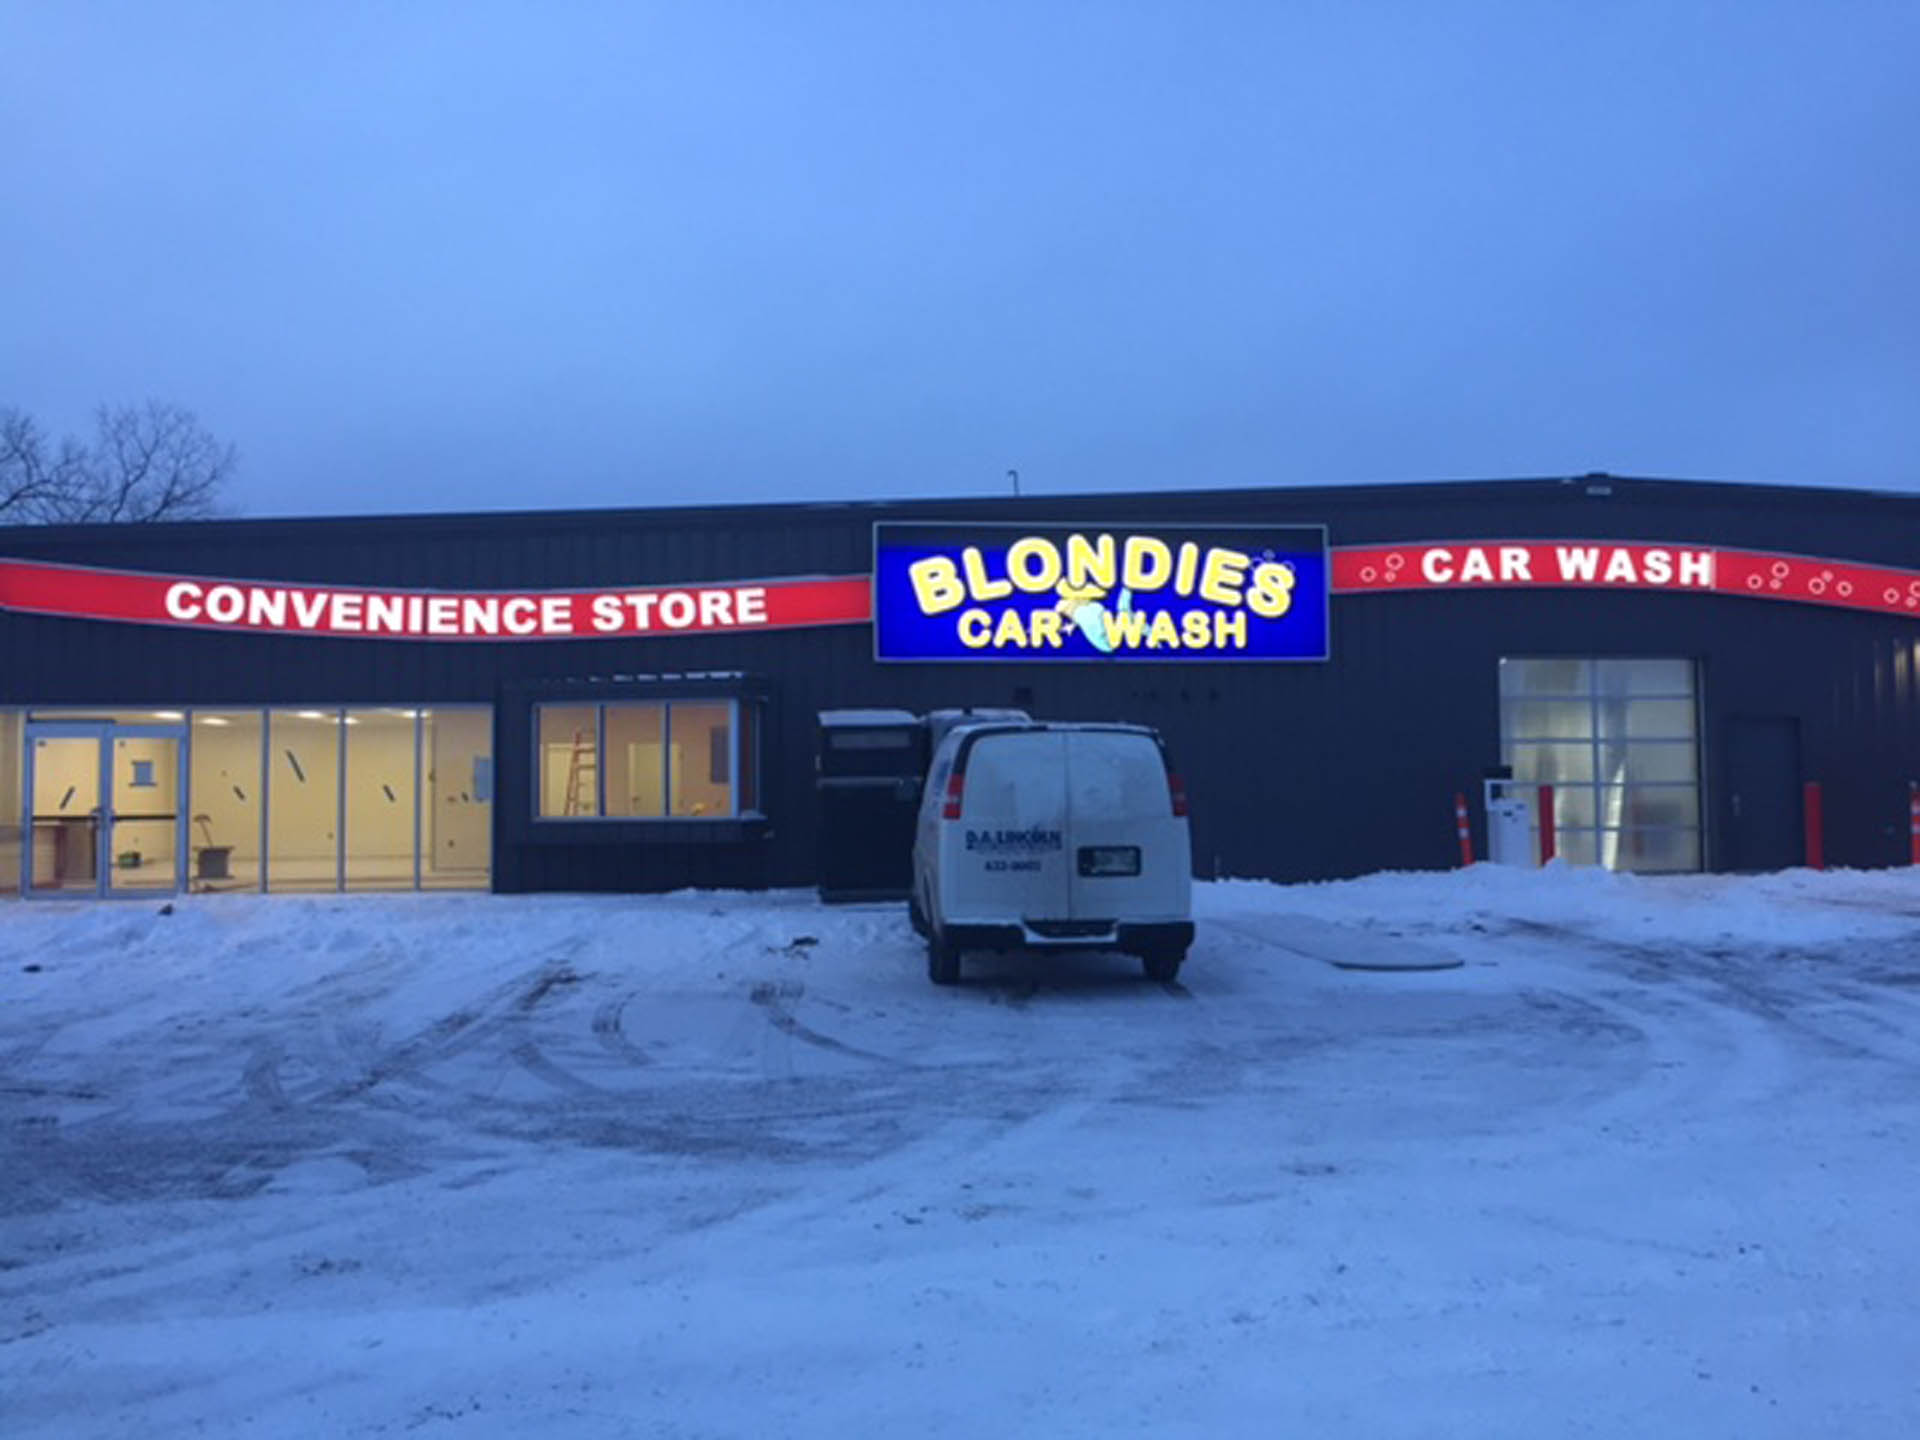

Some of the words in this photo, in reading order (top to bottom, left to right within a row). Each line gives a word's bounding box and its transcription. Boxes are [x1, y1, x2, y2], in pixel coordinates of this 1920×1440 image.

[908, 533, 1296, 618] BLONDIES
[1421, 547, 1533, 584] CAR
[1555, 546, 1713, 587] WASH
[165, 582, 574, 635] CONVENIENCE
[591, 587, 768, 632] STORE
[957, 609, 1063, 648] CAR
[1102, 609, 1247, 649] WASH
